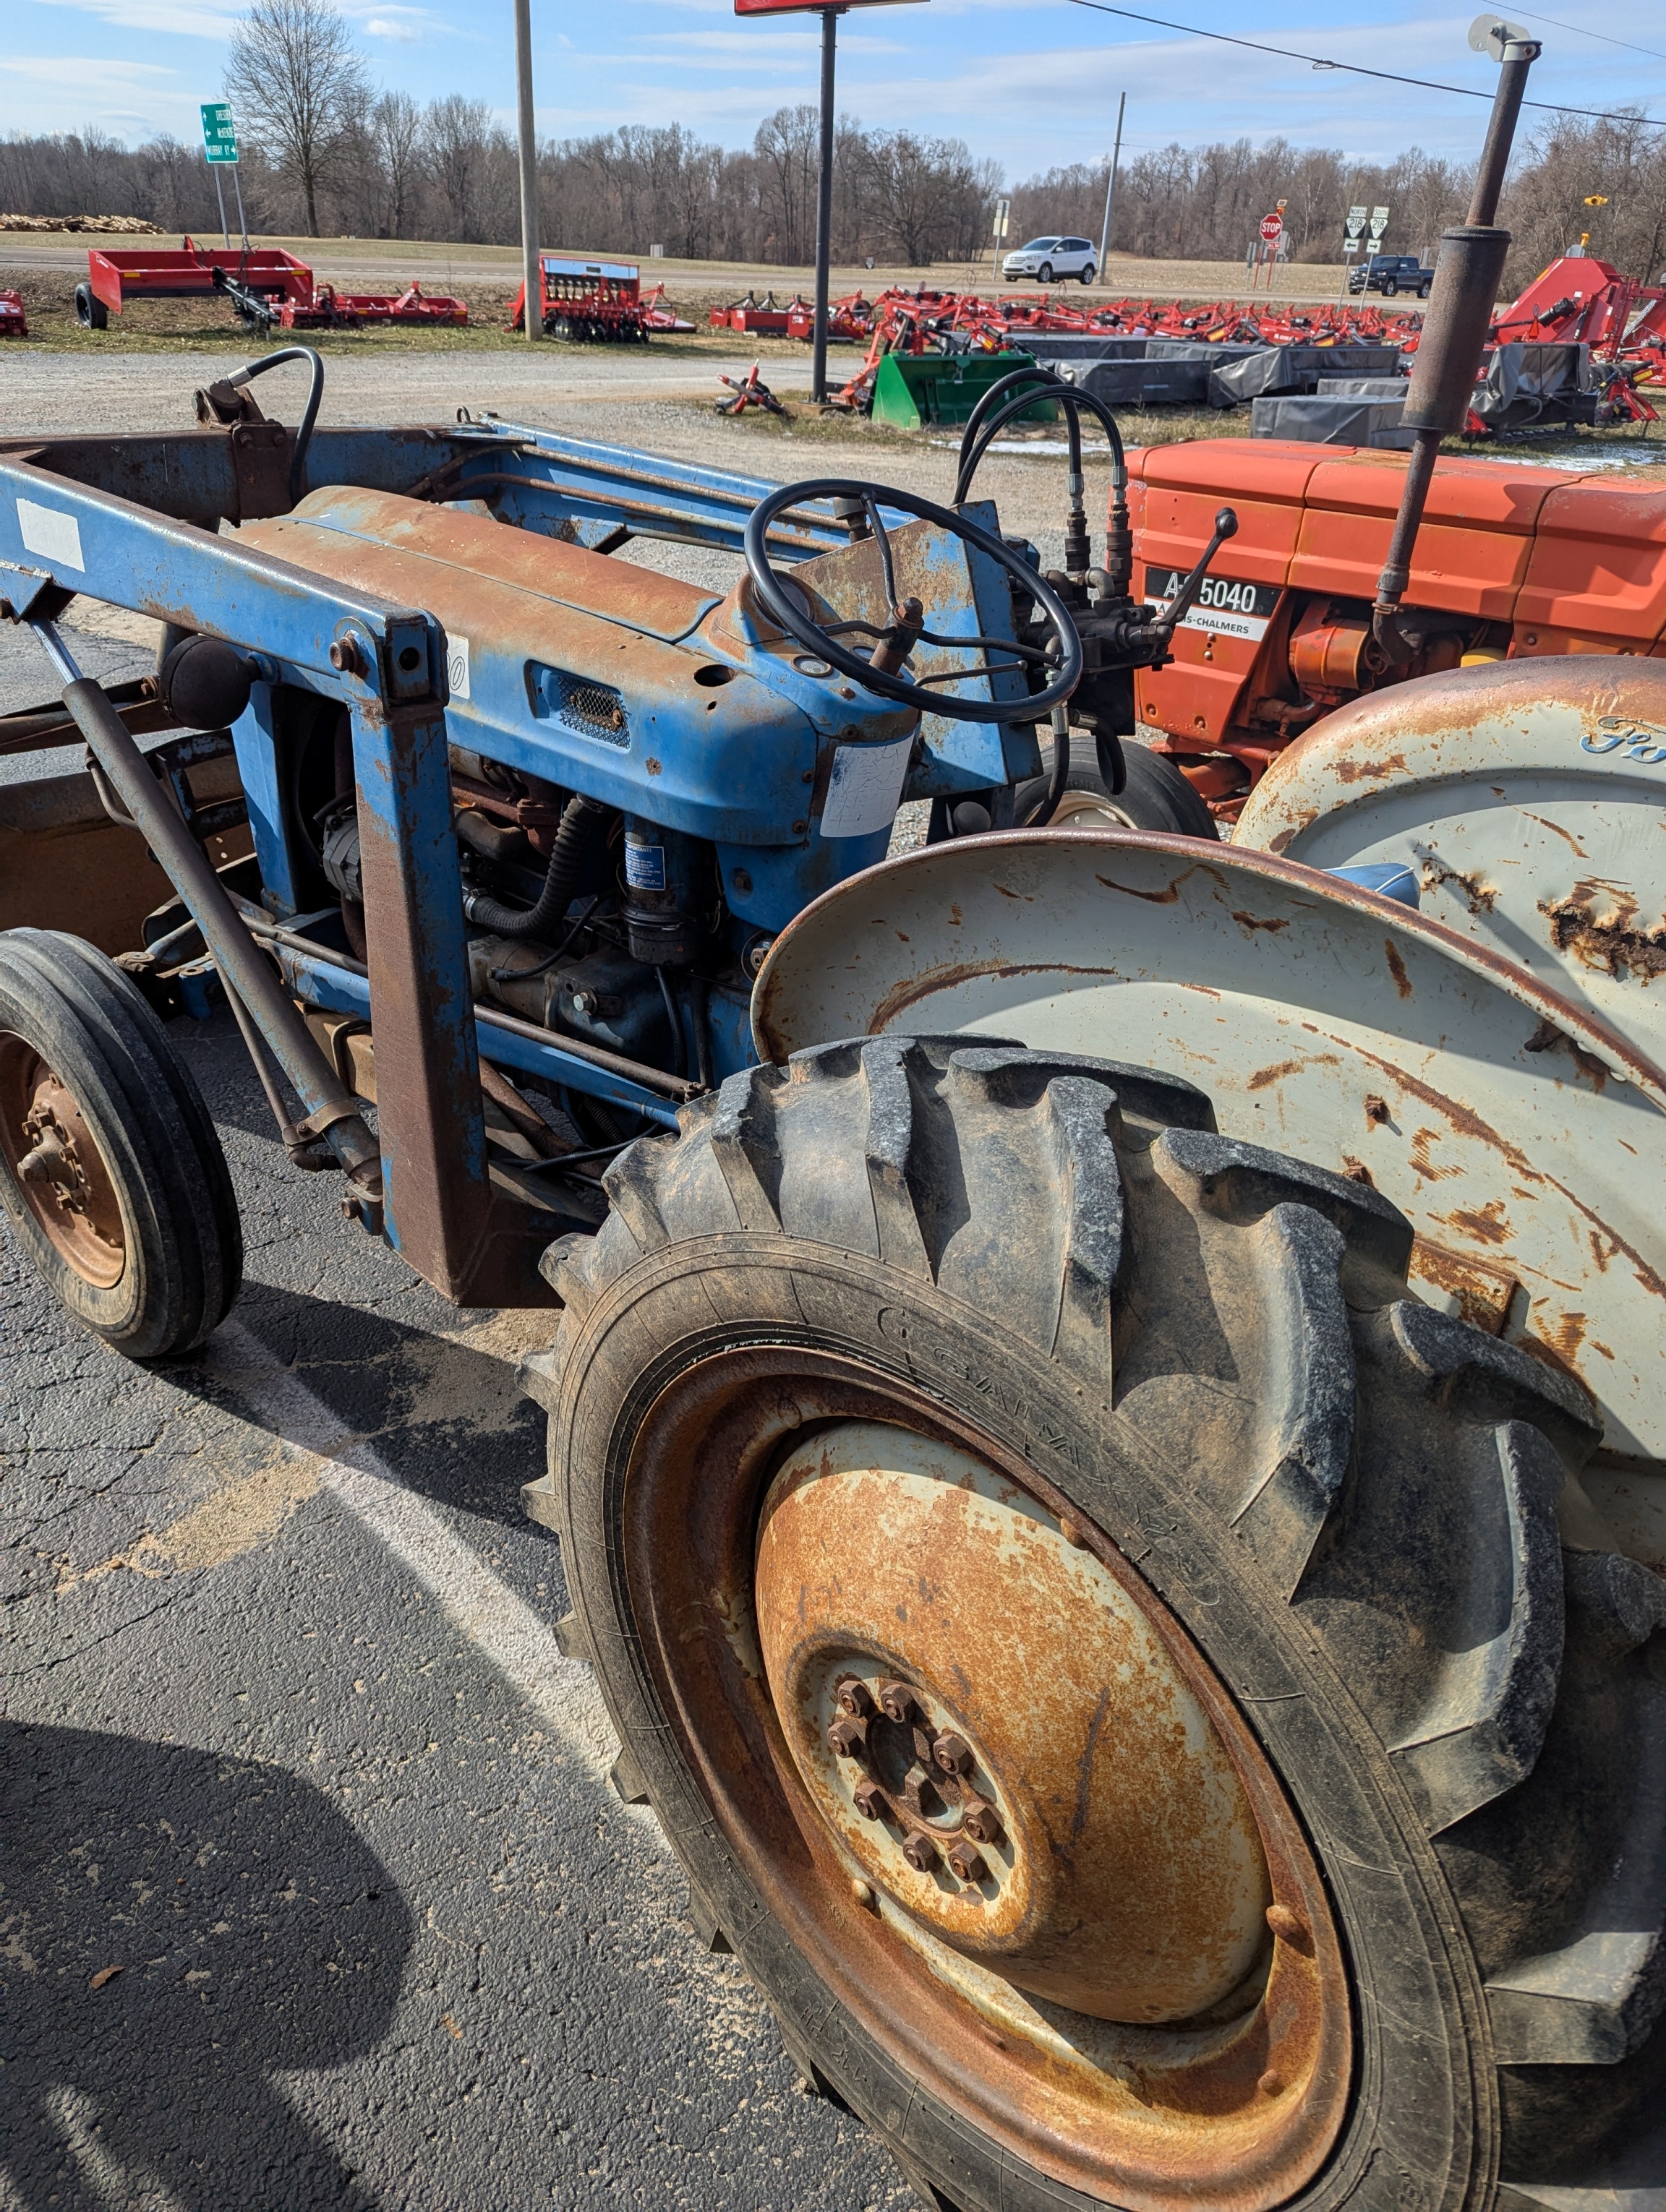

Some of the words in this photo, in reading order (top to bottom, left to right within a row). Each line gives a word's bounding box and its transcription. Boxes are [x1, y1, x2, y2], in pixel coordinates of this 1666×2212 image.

[1262, 223, 1281, 233] STOP
[1349, 218, 1363, 228] 218
[1372, 219, 1385, 229] 218
[1200, 578, 1256, 612] 5040
